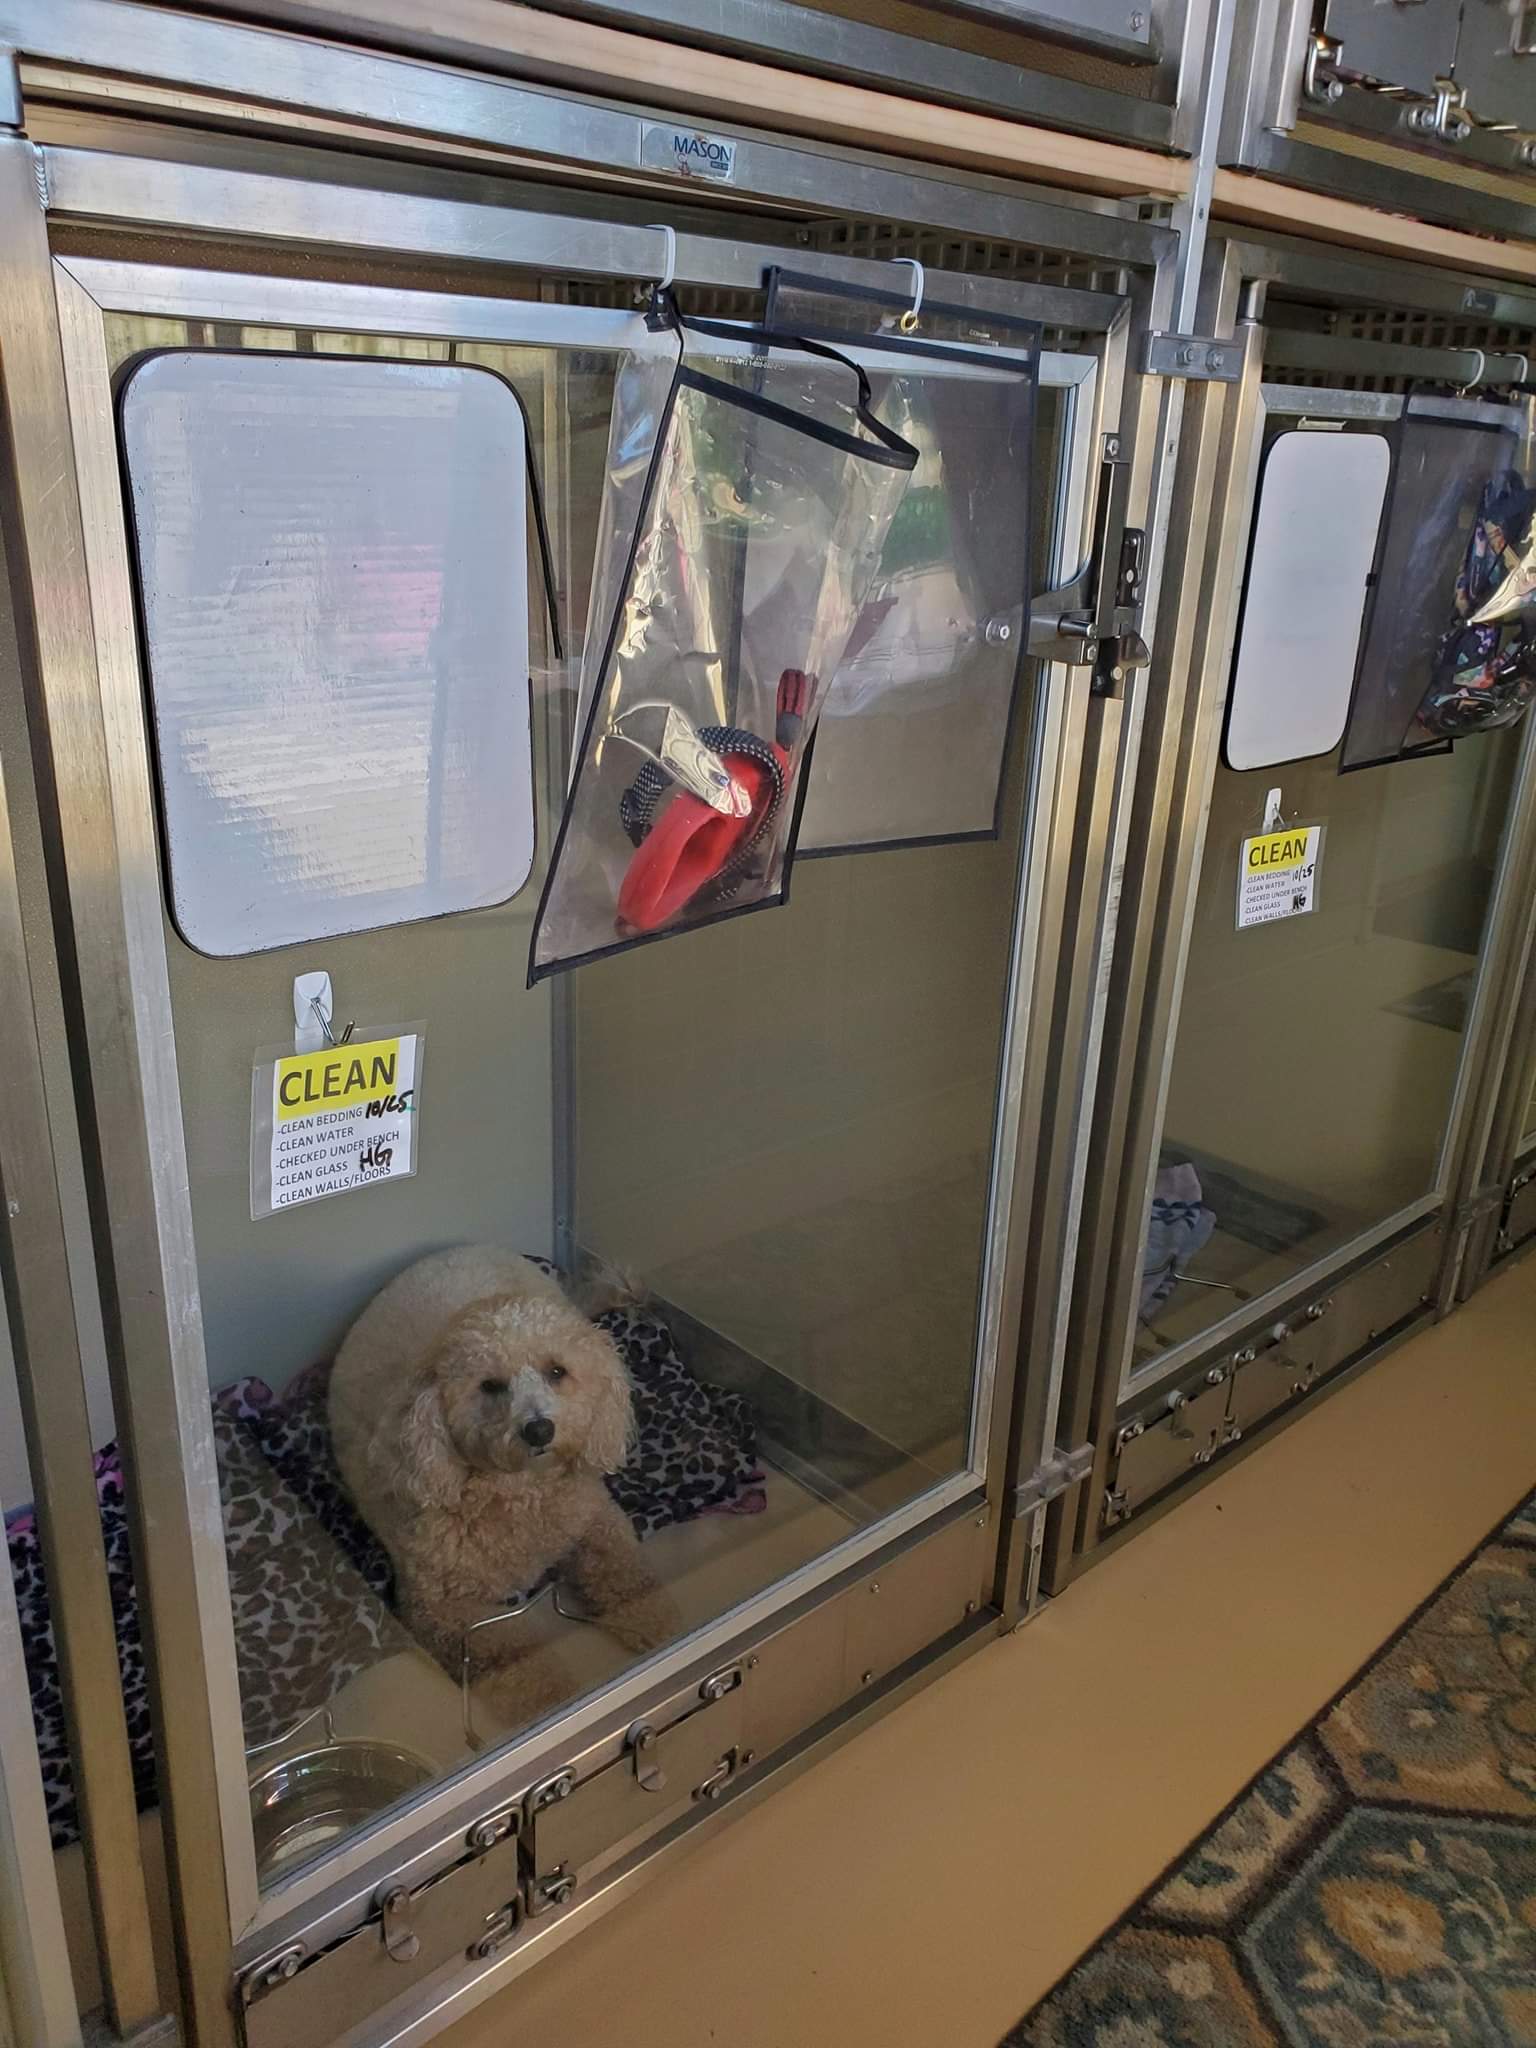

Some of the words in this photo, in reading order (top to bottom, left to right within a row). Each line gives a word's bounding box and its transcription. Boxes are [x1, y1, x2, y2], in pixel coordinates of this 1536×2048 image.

[674, 135, 732, 161] MASON
[1249, 837, 1307, 866] CLEAN
[1265, 881, 1285, 890] WATER
[1272, 890, 1290, 898] UNDER
[1292, 886, 1307, 894] BENCH
[1264, 901, 1280, 909] GLASS
[280, 1053, 396, 1106] CLEAN
[277, 1119, 313, 1135] -CLEAN
[316, 1107, 363, 1127] BEDDING
[275, 1149, 327, 1169] -CHECKED
[330, 1139, 364, 1157] UNDER
[367, 1130, 400, 1147] BENCH
[276, 1135, 313, 1152] -CLEAN
[316, 1127, 354, 1143] WATER
[275, 1169, 313, 1187] -CLEAN
[315, 1161, 348, 1177] GLASS
[275, 1187, 313, 1205] -CLEAN
[315, 1166, 391, 1192] WALLS/FLOORS
